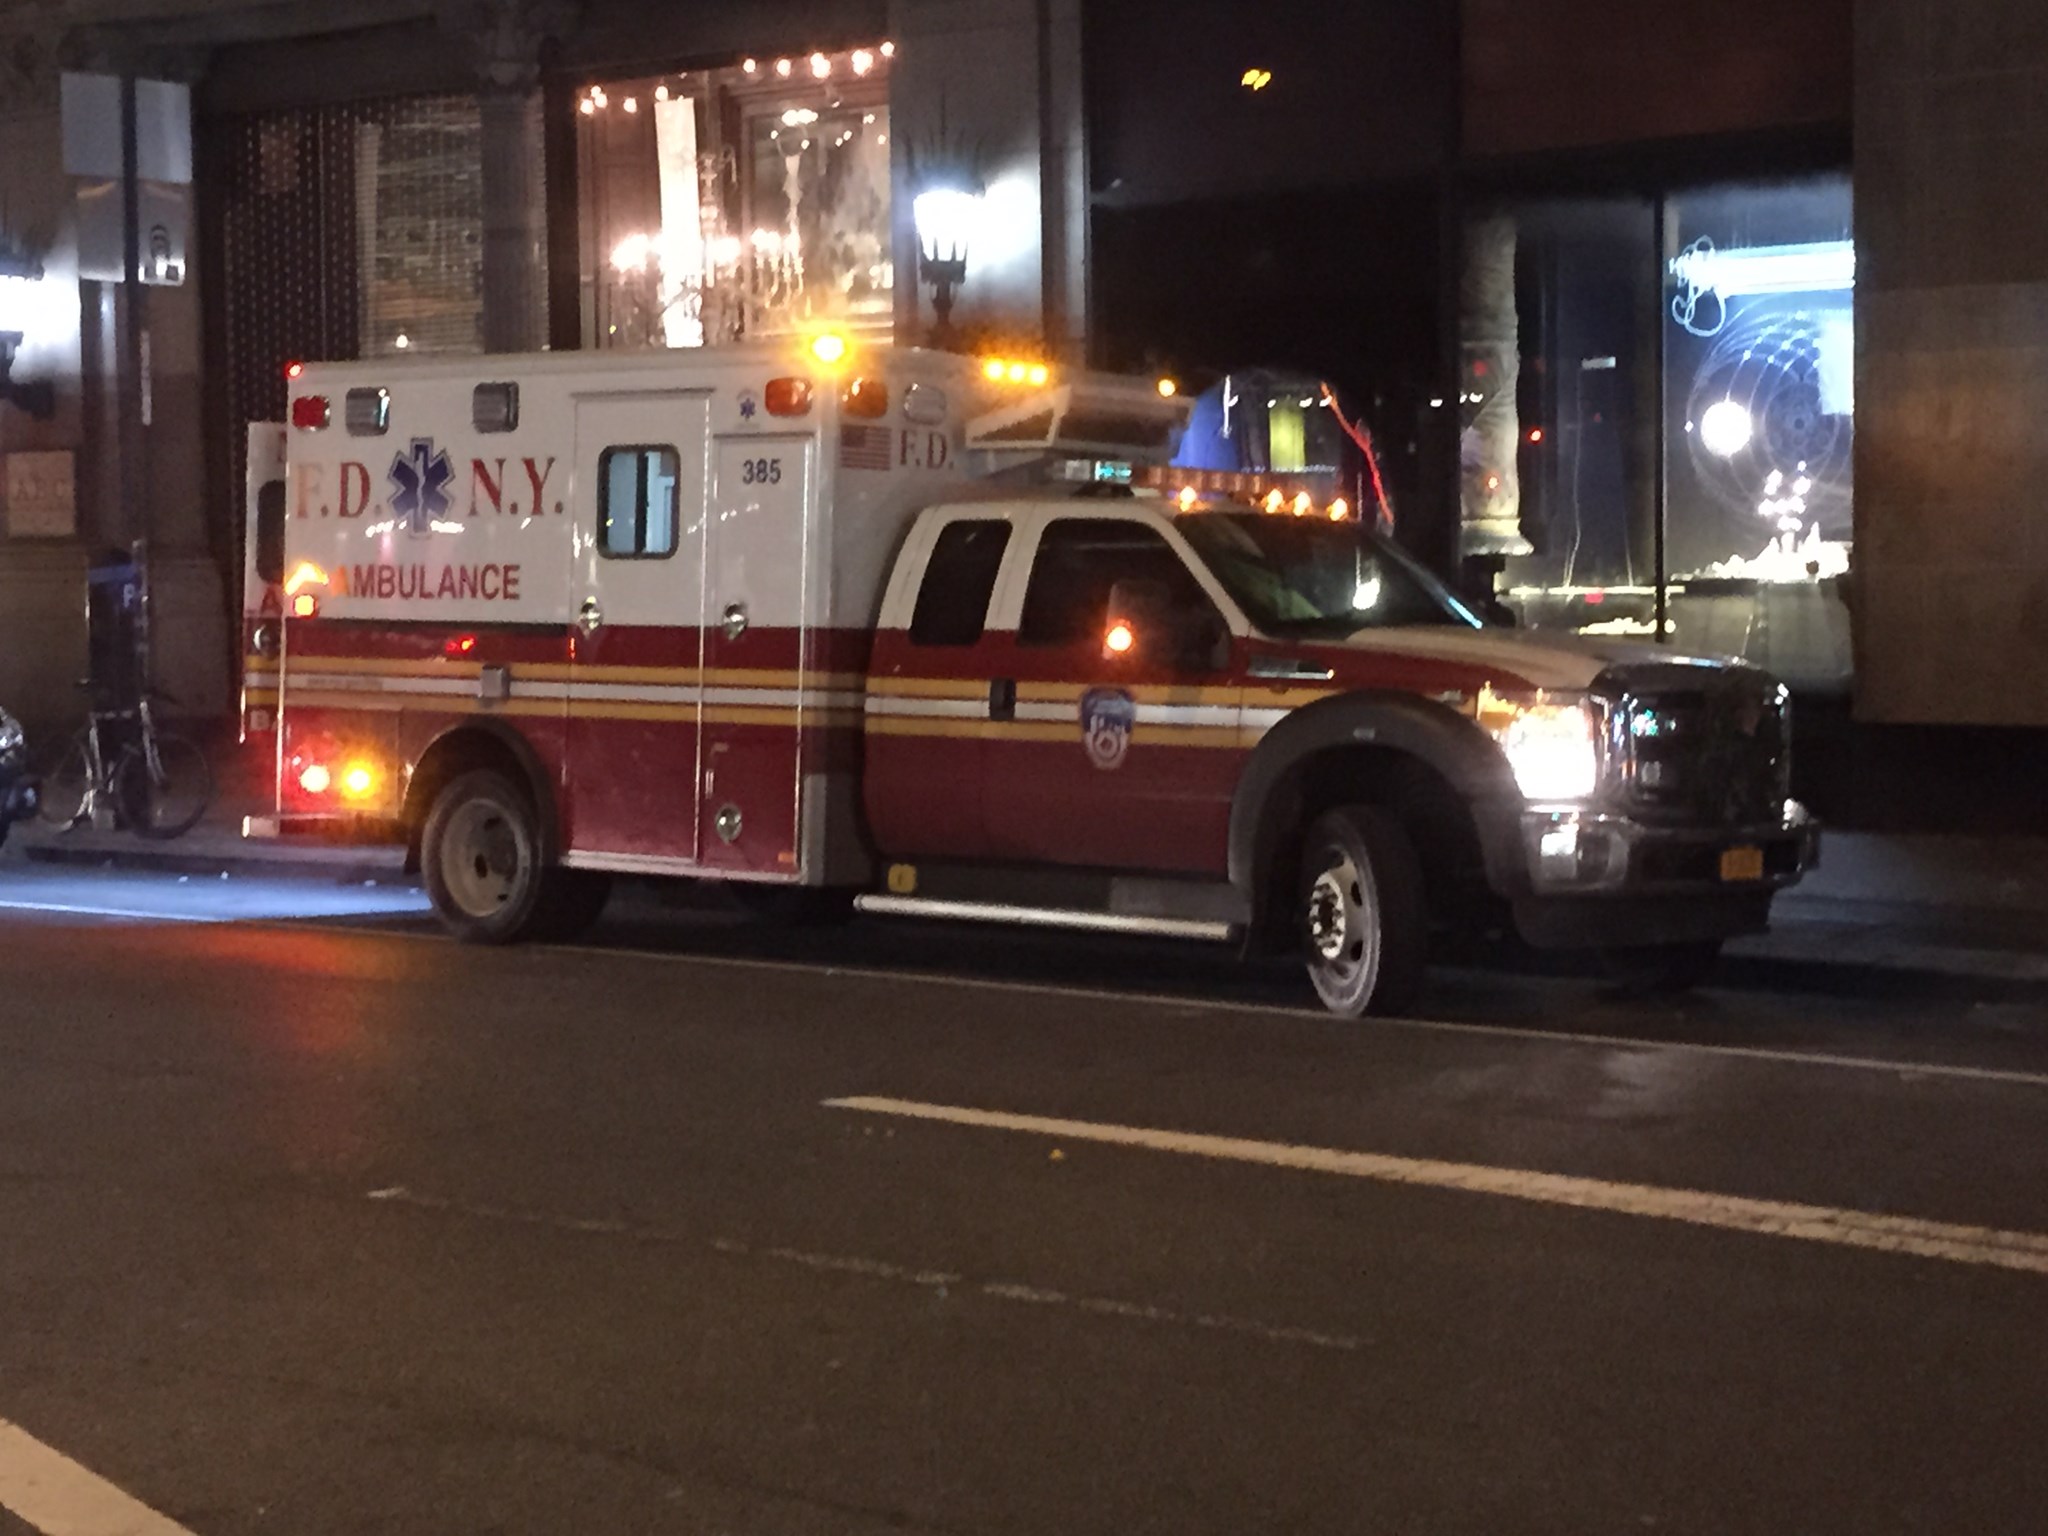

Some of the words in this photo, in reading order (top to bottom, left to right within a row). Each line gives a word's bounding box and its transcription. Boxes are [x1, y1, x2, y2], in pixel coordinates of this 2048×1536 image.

[900, 430, 954, 470] F.D.
[295, 460, 382, 518] F.D.
[468, 457, 564, 517] N.Y.
[742, 458, 782, 485] 385
